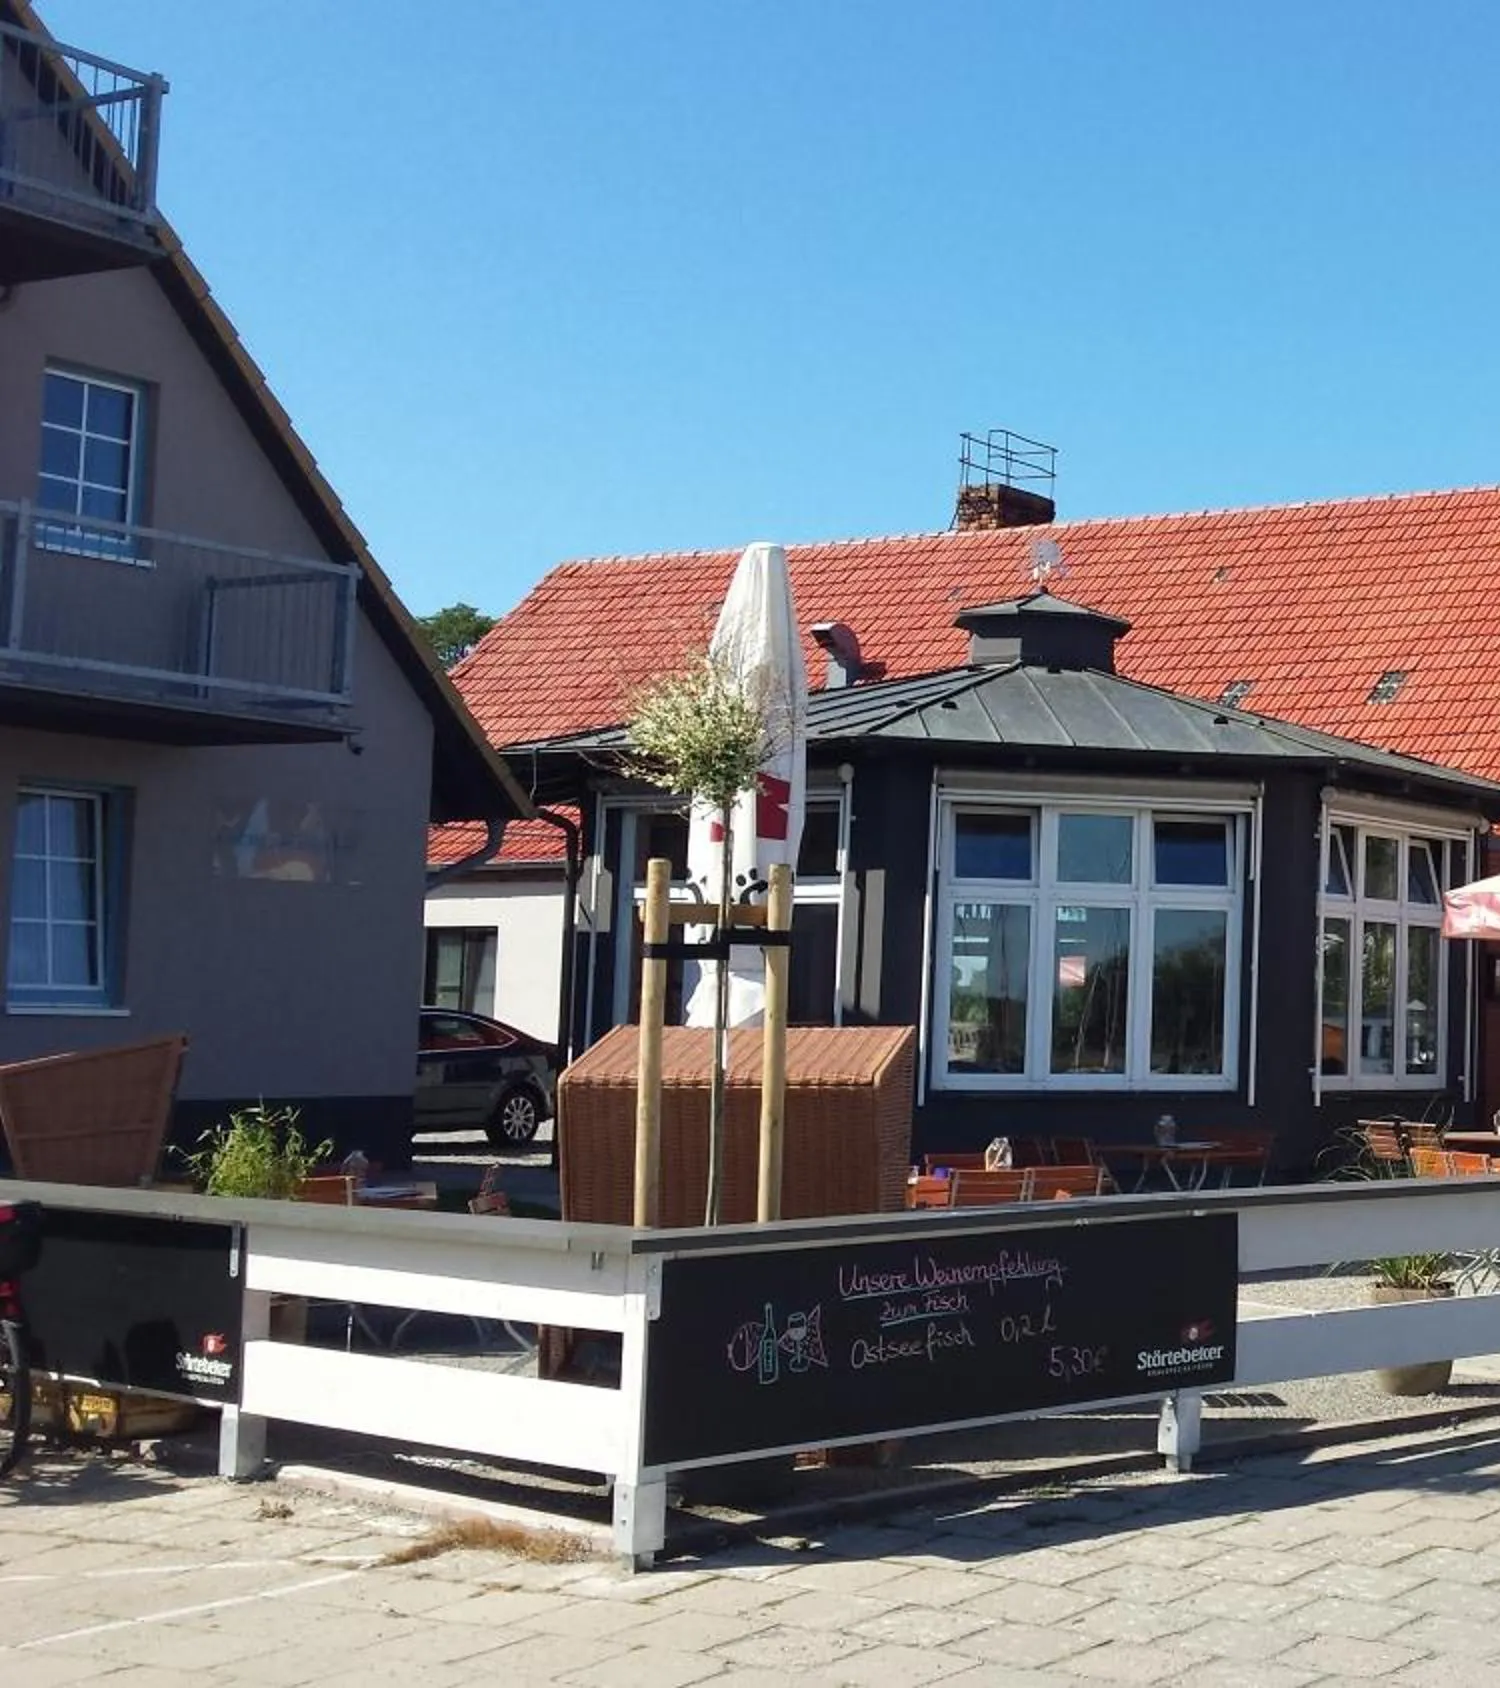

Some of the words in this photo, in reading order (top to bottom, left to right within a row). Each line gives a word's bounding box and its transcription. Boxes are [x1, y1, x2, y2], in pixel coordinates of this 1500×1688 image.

[839, 1264, 910, 1297] Unsere
[914, 1250, 1066, 1296] Weinempfehlung
[923, 1290, 970, 1314] Fisch
[1136, 1346, 1225, 1371] Störtebeker
